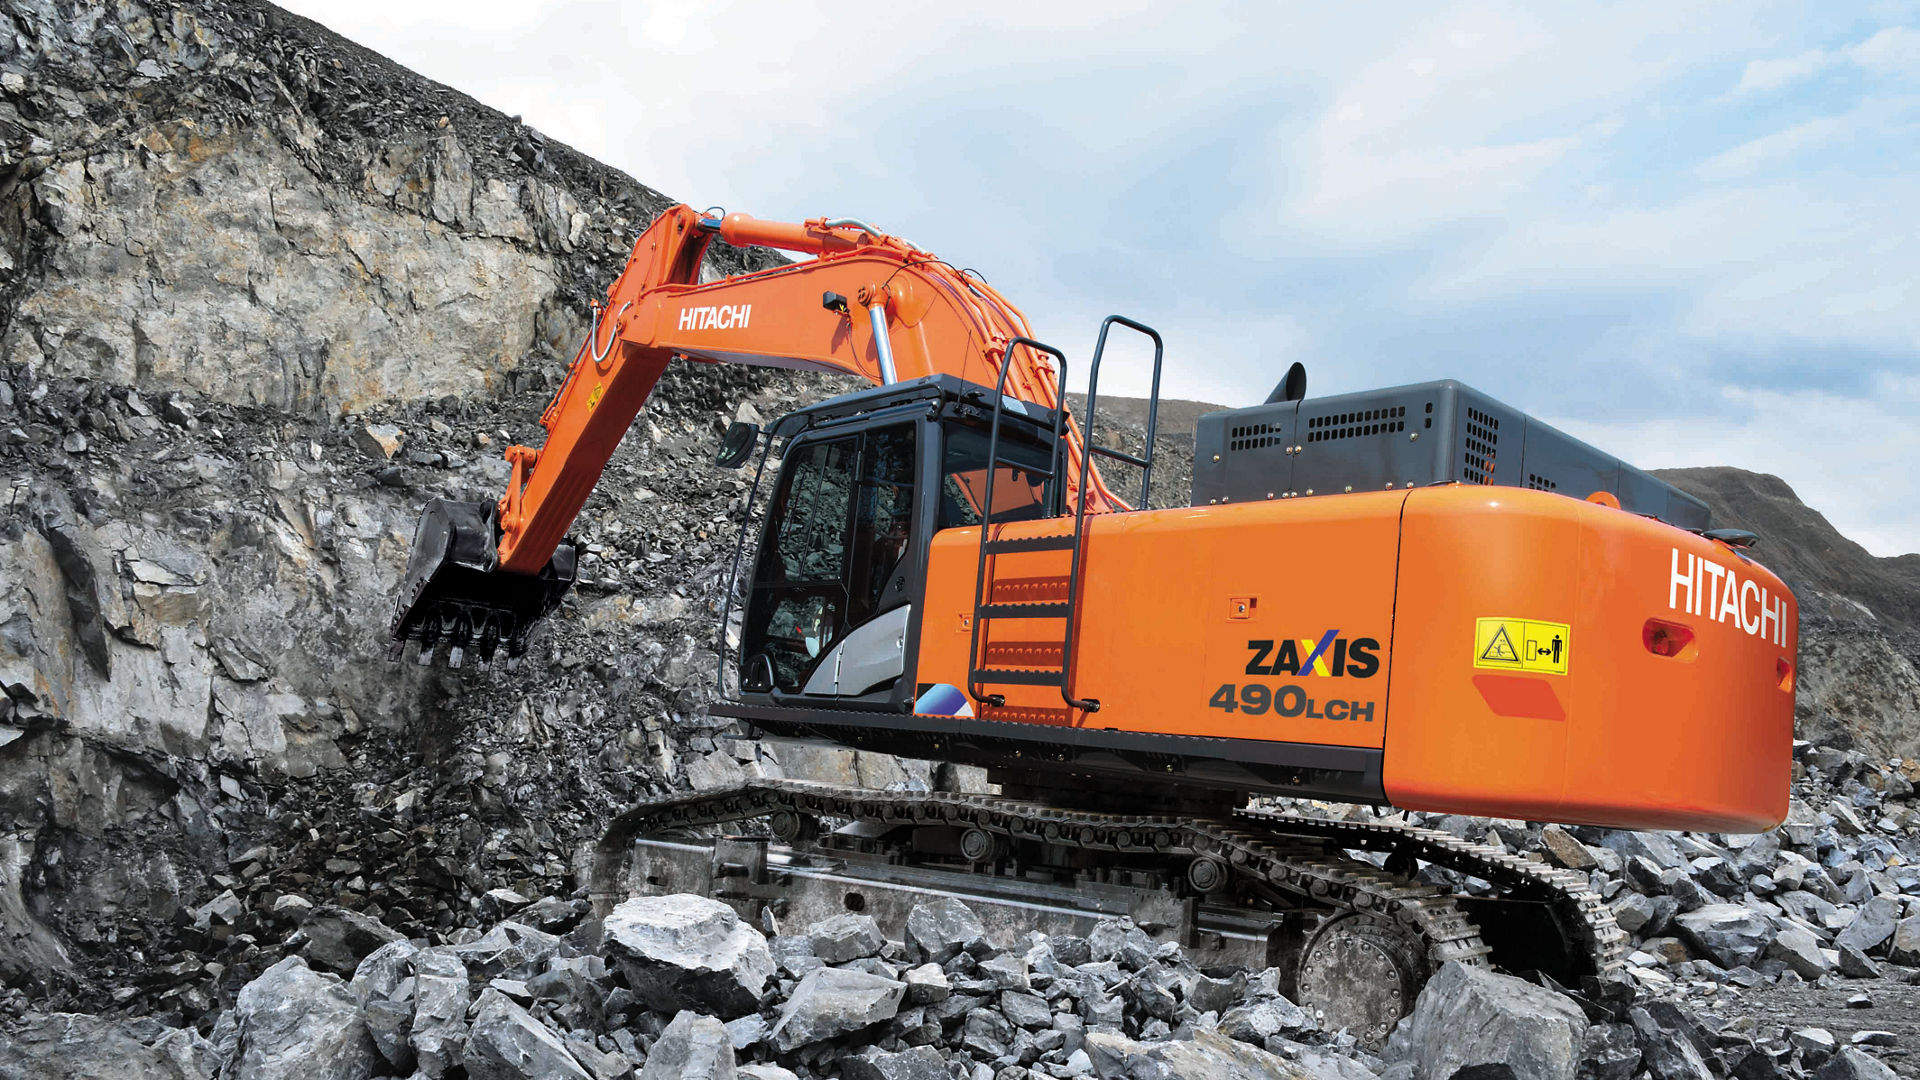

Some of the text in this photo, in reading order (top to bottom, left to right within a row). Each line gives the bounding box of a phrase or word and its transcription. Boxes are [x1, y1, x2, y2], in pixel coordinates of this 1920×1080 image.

[678, 304, 751, 330] HITACHI
[1669, 548, 1787, 648] HITACHI
[1245, 629, 1380, 678] ZAXIS
[1209, 684, 1375, 721] 490LCH
